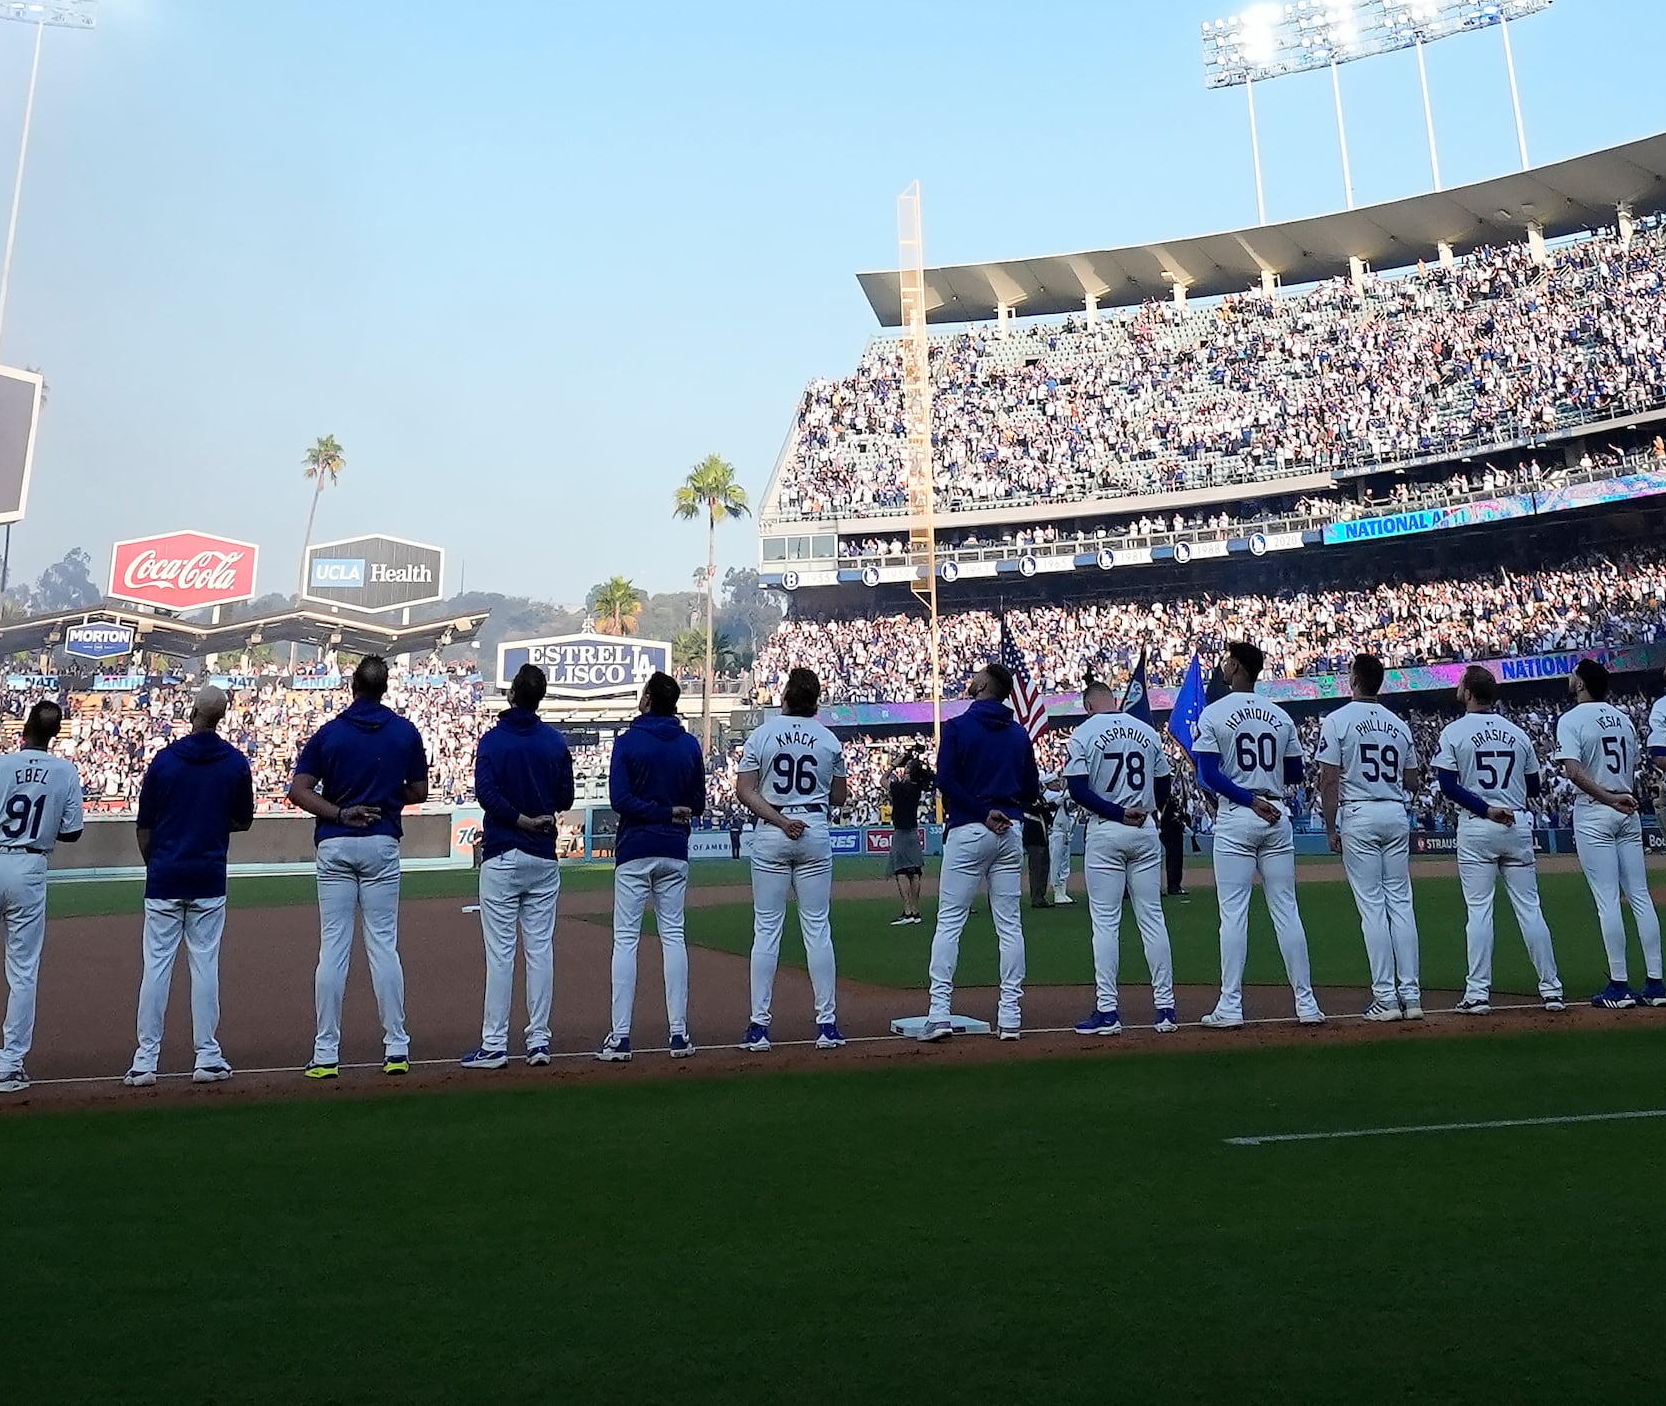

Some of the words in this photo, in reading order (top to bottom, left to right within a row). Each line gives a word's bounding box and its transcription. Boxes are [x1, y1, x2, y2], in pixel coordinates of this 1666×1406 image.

[1345, 513, 1429, 538] NATIONAL
[124, 550, 244, 590] Coca-Cola
[316, 565, 360, 582] UCLA
[370, 563, 432, 582] Health
[69, 629, 130, 643] MORTON
[547, 664, 626, 685] LISCO
[1502, 653, 1579, 680] NATIONA
[1225, 707, 1283, 733] HENRIQUEZ
[1355, 721, 1400, 739] PHILLIPS
[775, 731, 818, 749] KNACK
[1093, 726, 1151, 751] CASPARIUS
[1471, 729, 1517, 747] BRASIER
[1235, 732, 1277, 772] 60
[1359, 743, 1399, 784] 59
[1601, 736, 1628, 774] 51
[15, 767, 49, 786] EBEL
[772, 753, 818, 795] 96
[1103, 751, 1146, 793] 78
[1475, 750, 1516, 790] 57
[1, 793, 48, 840] 91
